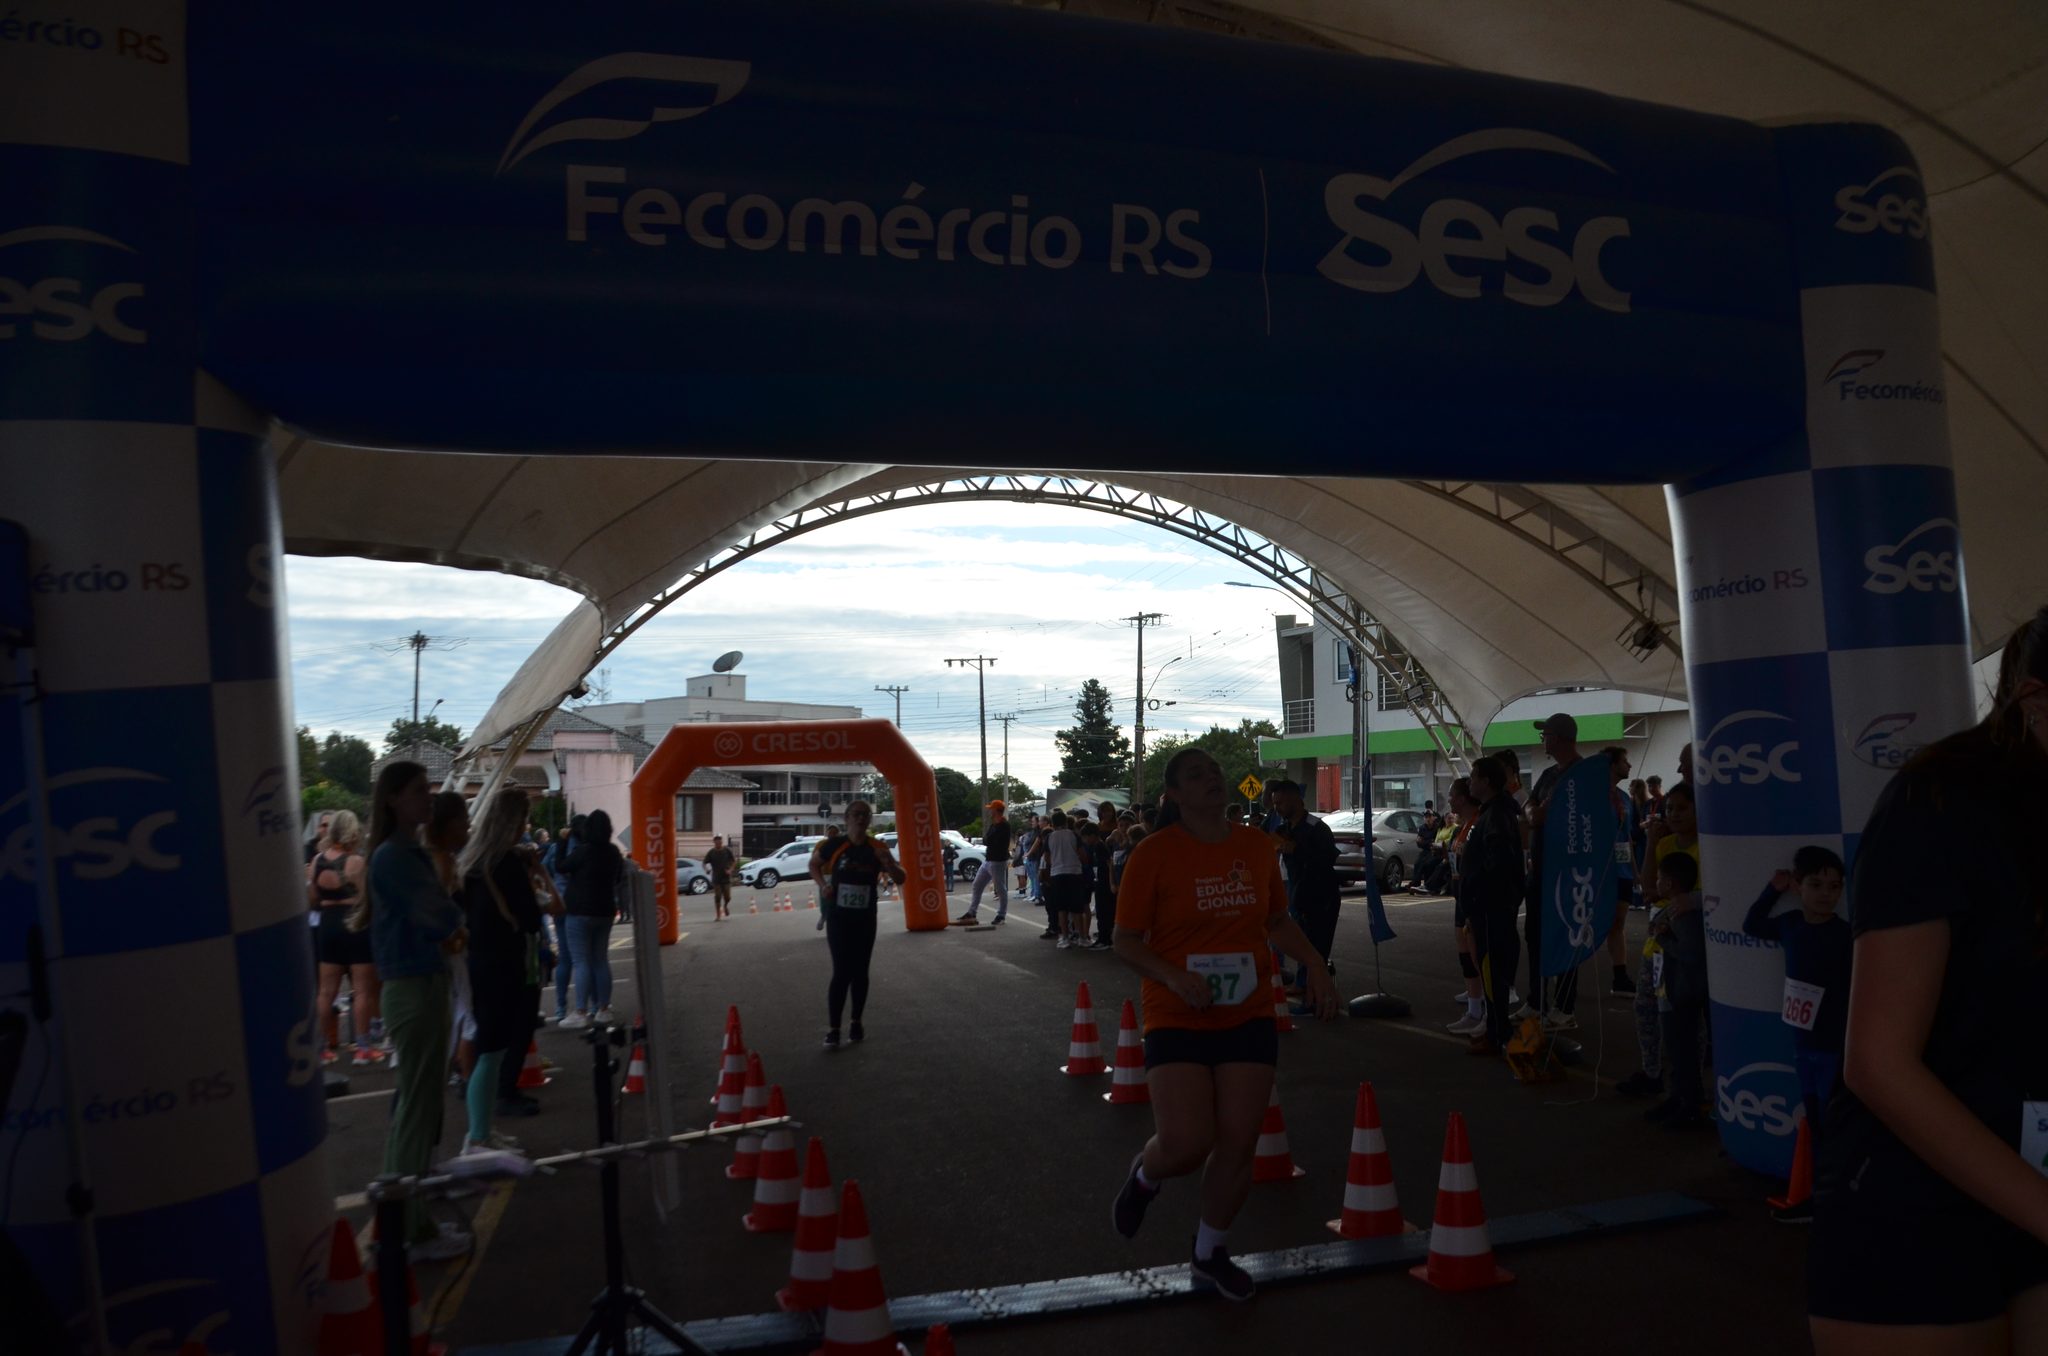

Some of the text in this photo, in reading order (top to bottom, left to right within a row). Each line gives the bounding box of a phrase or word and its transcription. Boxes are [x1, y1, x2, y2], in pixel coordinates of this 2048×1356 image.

[117, 27, 169, 65] RS
[566, 164, 1213, 279] Fecomércio RS
[1834, 184, 1928, 240] Ses
[1316, 172, 1632, 314] Sesc
[141, 563, 190, 591] RS
[1774, 568, 1809, 590] RS
[752, 731, 856, 753] CRESOL
[1566, 778, 1578, 855] Fecomércio
[914, 795, 937, 881] CRESOL
[1197, 893, 1257, 911] CIONAIS
[1568, 866, 1595, 949] Sesc
[1208, 973, 1240, 1001] 87
[1786, 996, 1813, 1025] 266
[189, 1071, 234, 1106] RS
